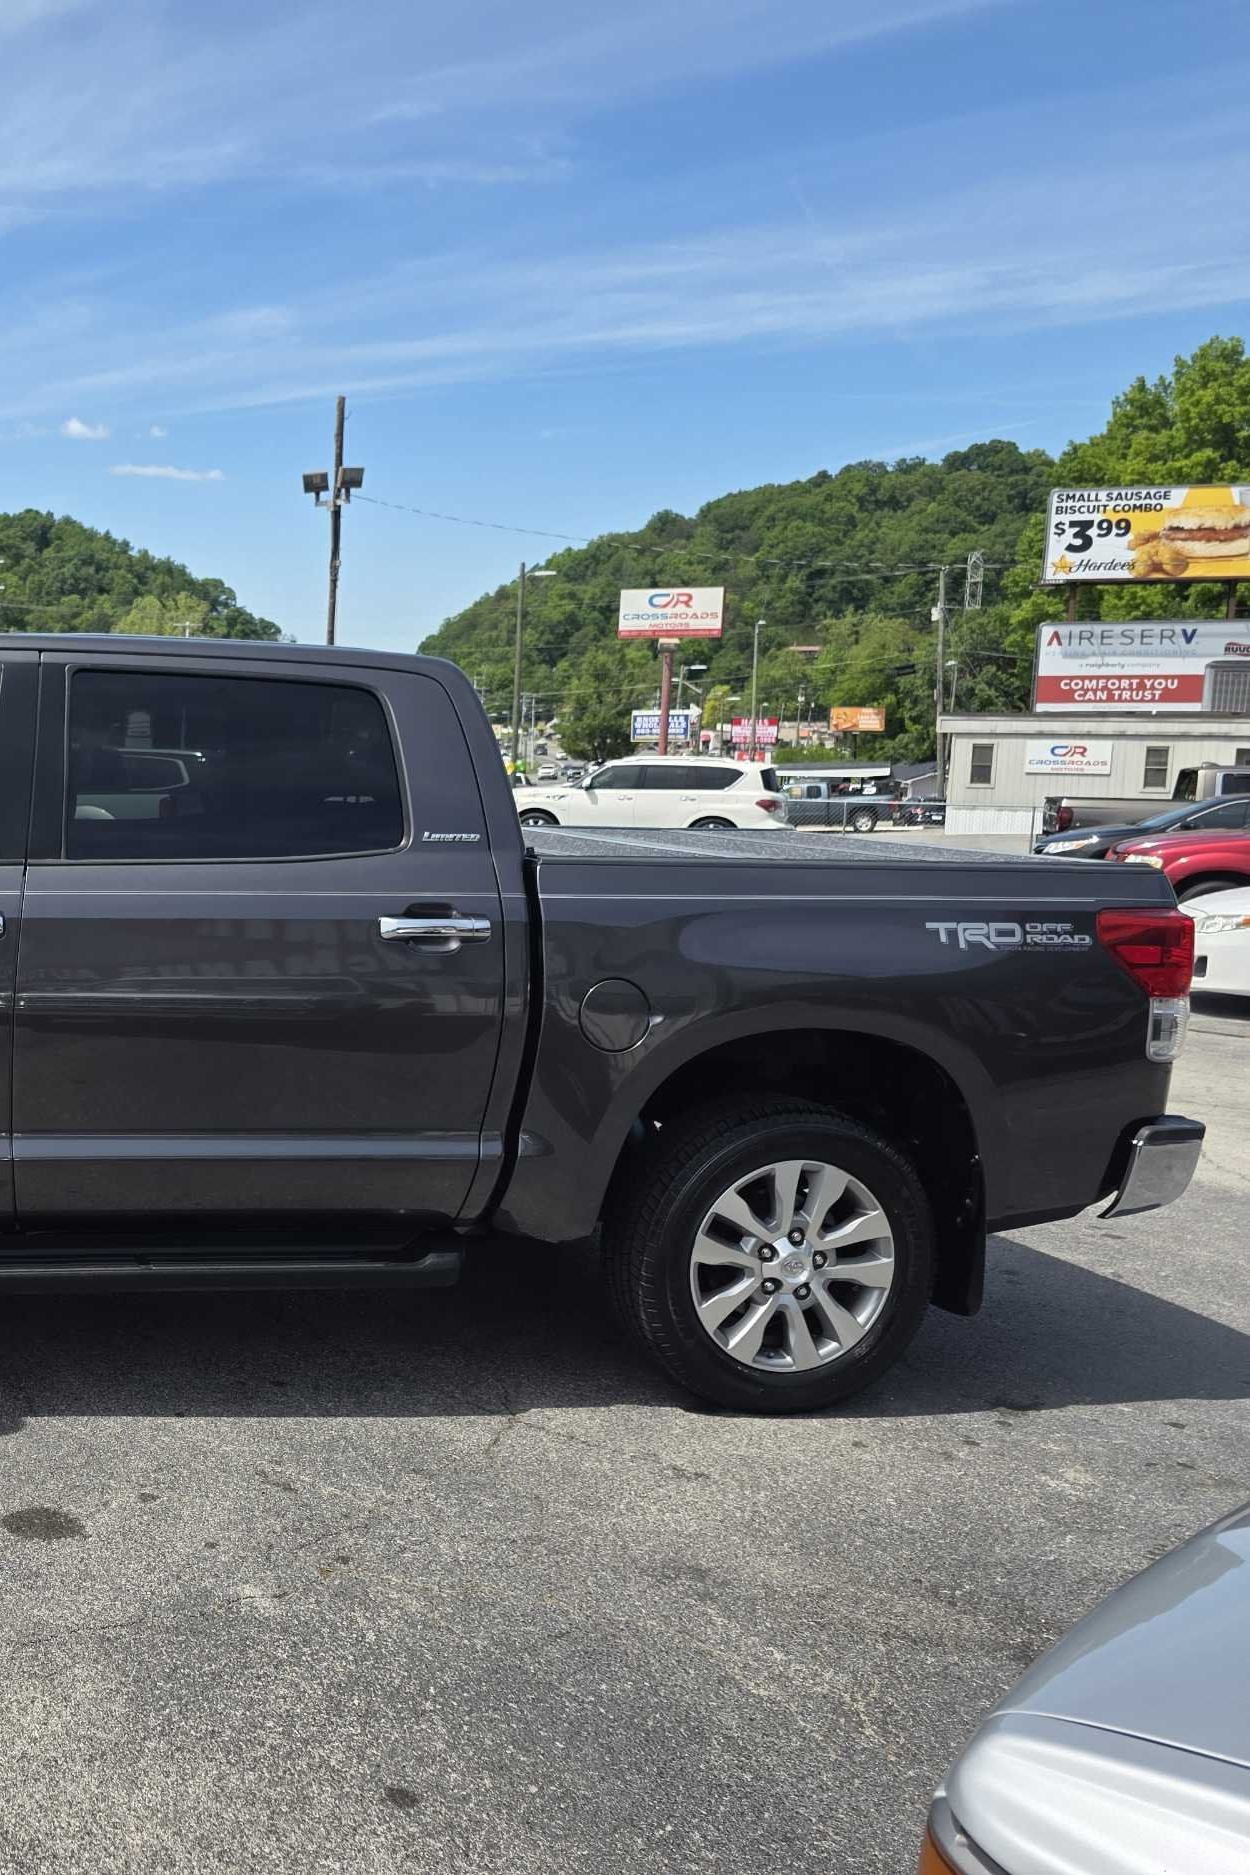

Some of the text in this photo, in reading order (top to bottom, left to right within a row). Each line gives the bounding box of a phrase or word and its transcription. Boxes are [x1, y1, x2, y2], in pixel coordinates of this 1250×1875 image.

[1056, 490, 1172, 504] SMALL SAUSAGE
[1055, 502, 1164, 515] BISCUIT COMBO
[622, 611, 719, 621] CROSSROADS
[1060, 679, 1179, 690] COMFORT YOU
[1073, 690, 1163, 701] CAN TRUST
[1028, 759, 1108, 767] CROSSROADS
[925, 921, 1074, 950] TRD OFF
[1025, 934, 1092, 945] ROAD
